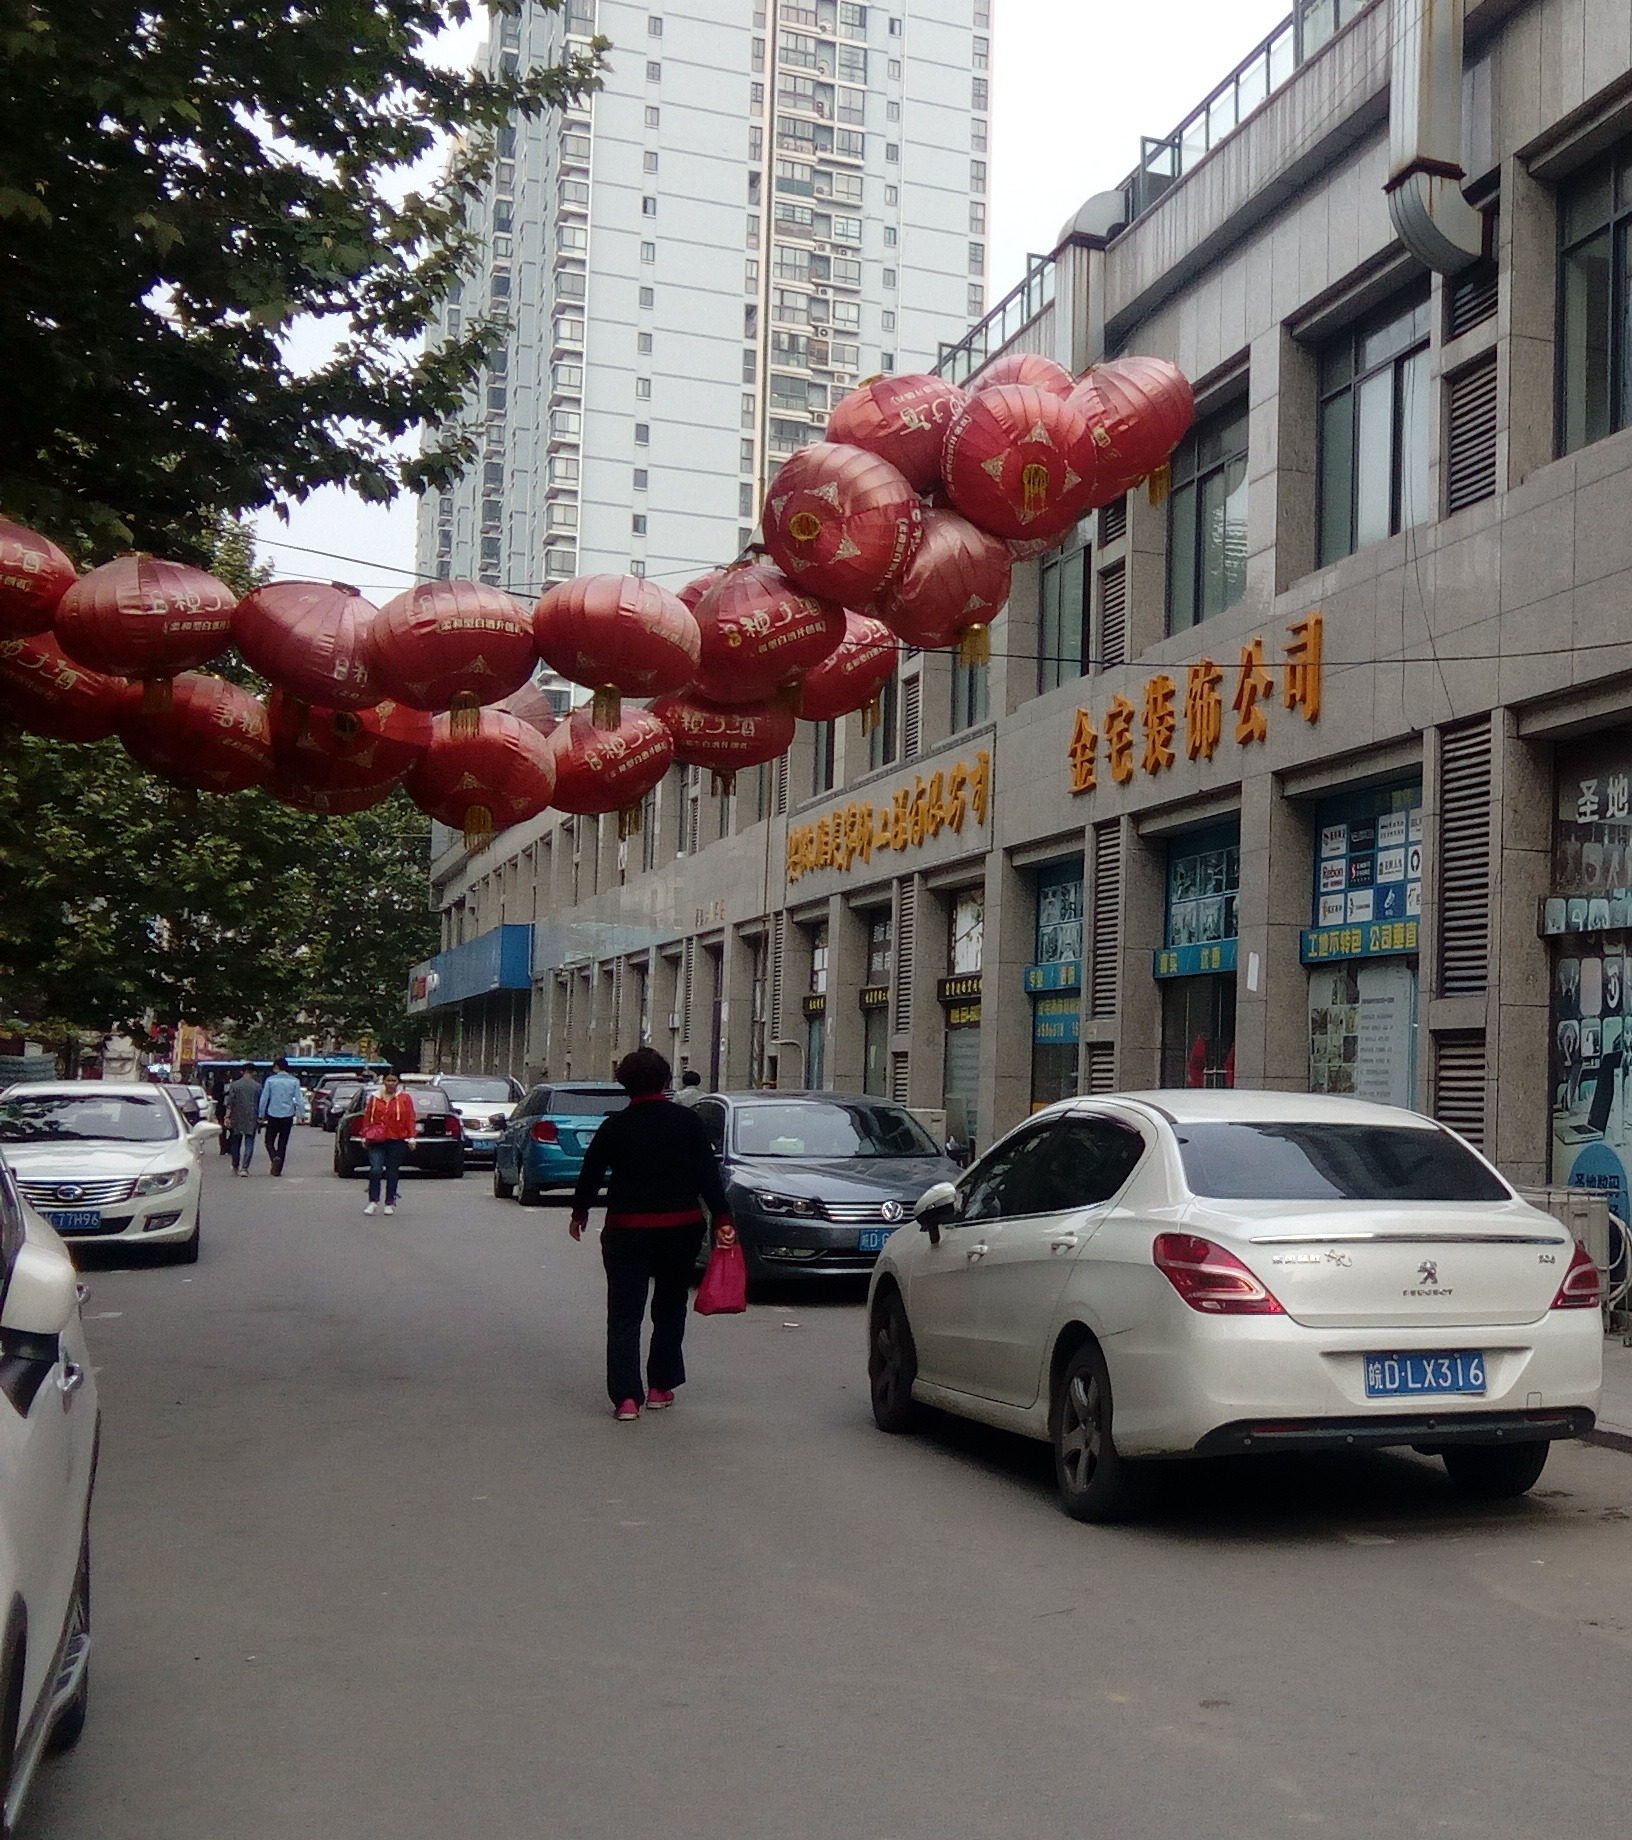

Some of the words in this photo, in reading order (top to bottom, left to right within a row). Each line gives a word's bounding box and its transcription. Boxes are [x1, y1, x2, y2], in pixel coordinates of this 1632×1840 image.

[1067, 609, 1323, 797] 金宅装饰公司
